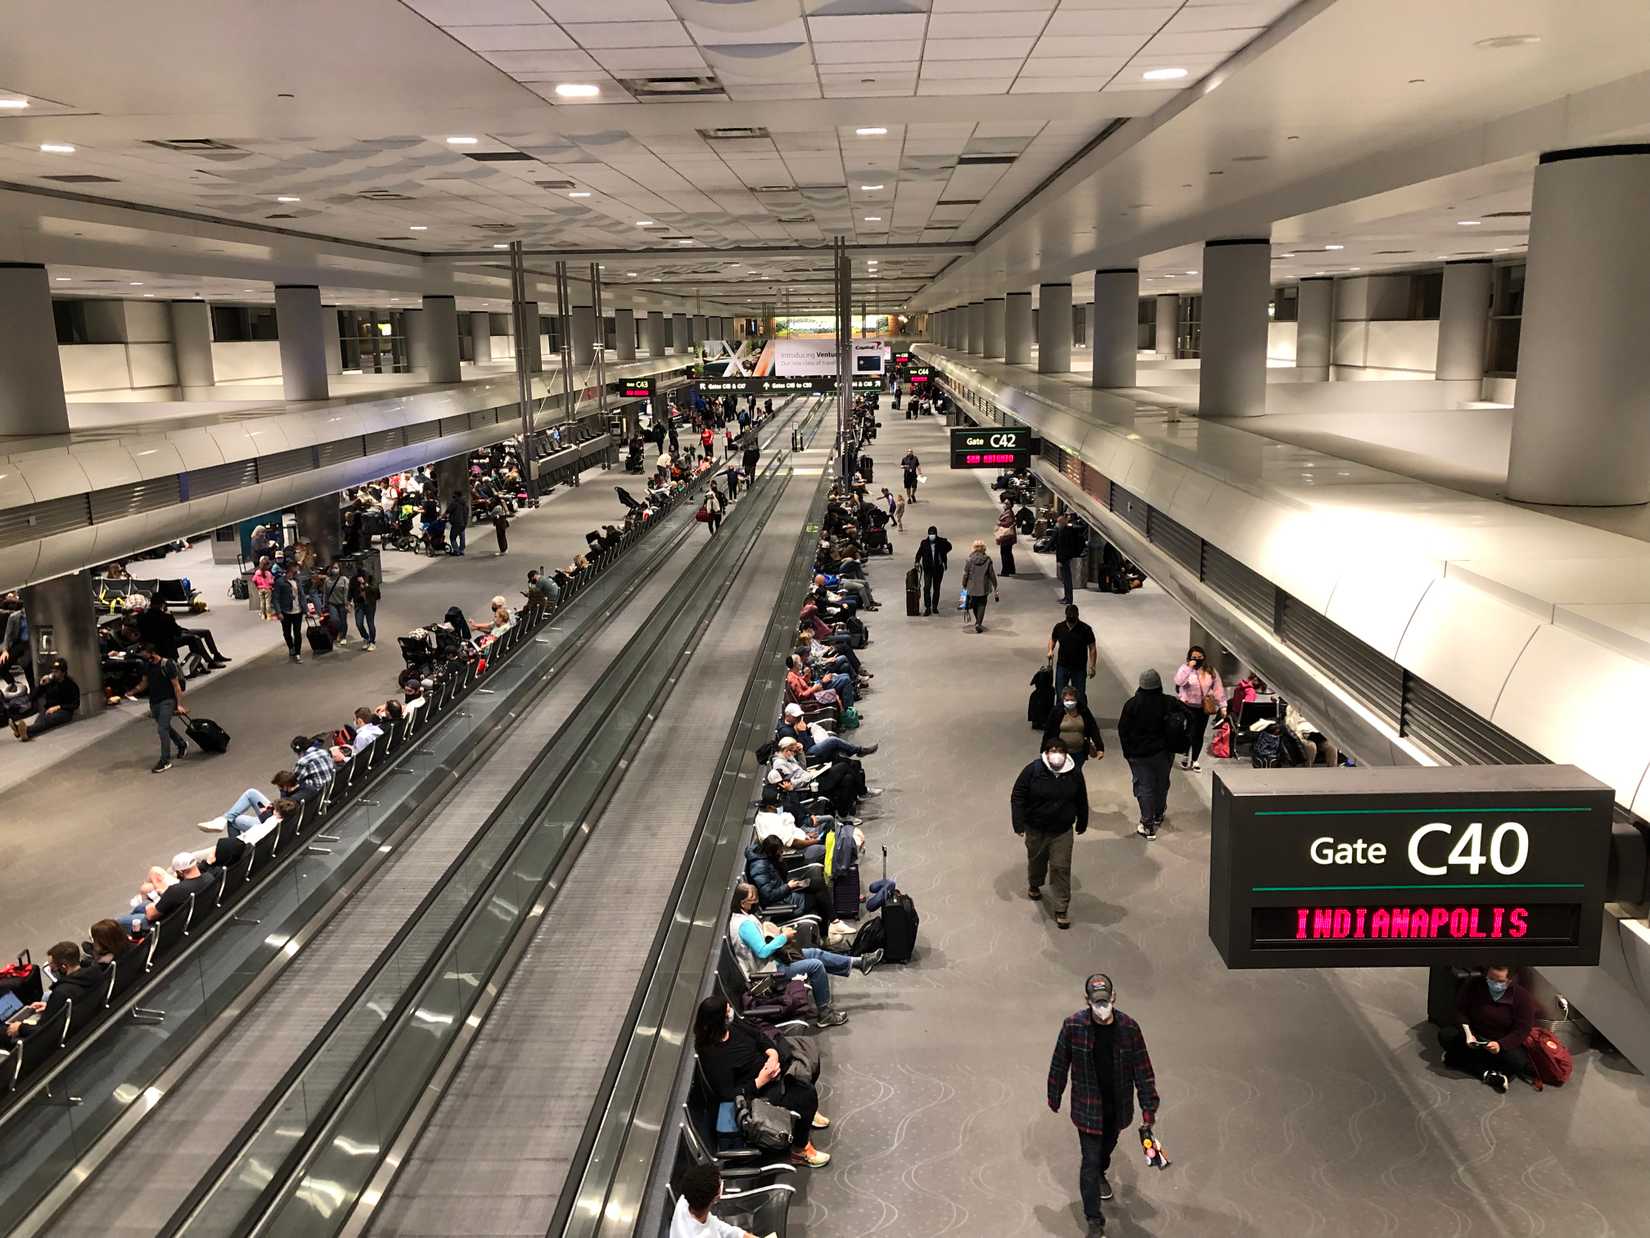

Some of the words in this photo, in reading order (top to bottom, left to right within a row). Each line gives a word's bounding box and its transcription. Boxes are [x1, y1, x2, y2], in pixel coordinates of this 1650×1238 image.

[635, 380, 648, 388] C43
[966, 437, 984, 446] Gate
[990, 434, 1016, 448] C42
[1310, 836, 1387, 865] Gate
[1407, 821, 1529, 876] C40
[1296, 907, 1529, 939] INDIANAPOLIS
